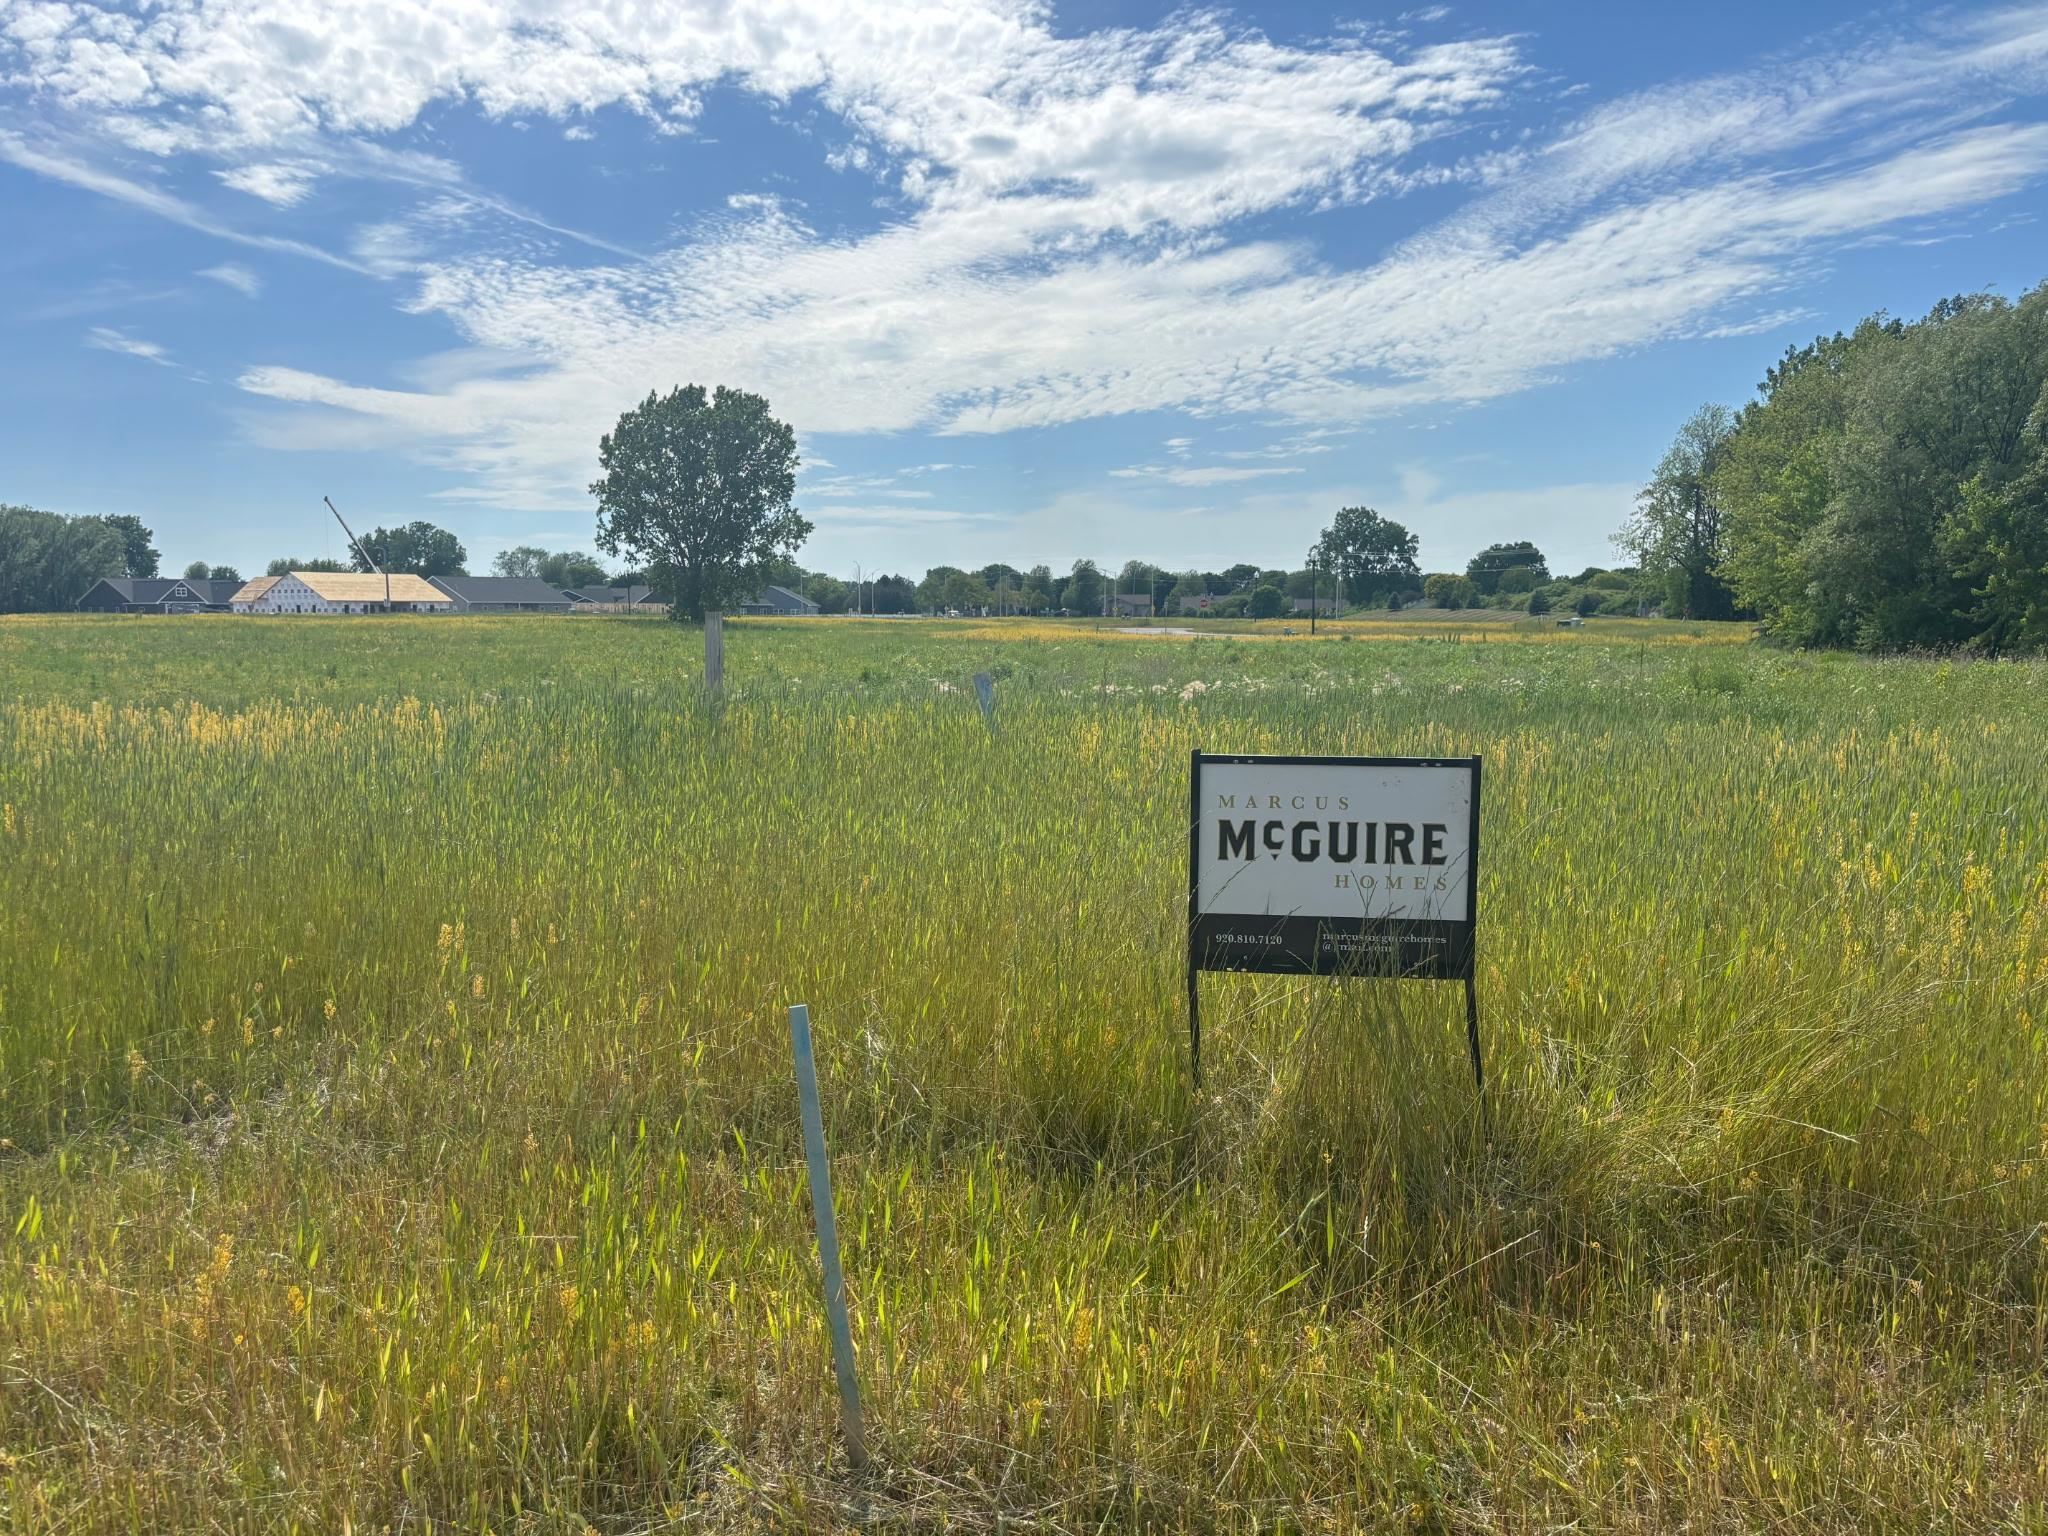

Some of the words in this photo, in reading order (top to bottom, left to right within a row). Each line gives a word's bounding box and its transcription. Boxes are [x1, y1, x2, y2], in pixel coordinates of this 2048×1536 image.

[1219, 795, 1349, 810] MARCUS
[1335, 875, 1448, 890] HOMES
[1215, 933, 1283, 945] 920.810.7120
[1322, 941, 1393, 952] @mail.com
